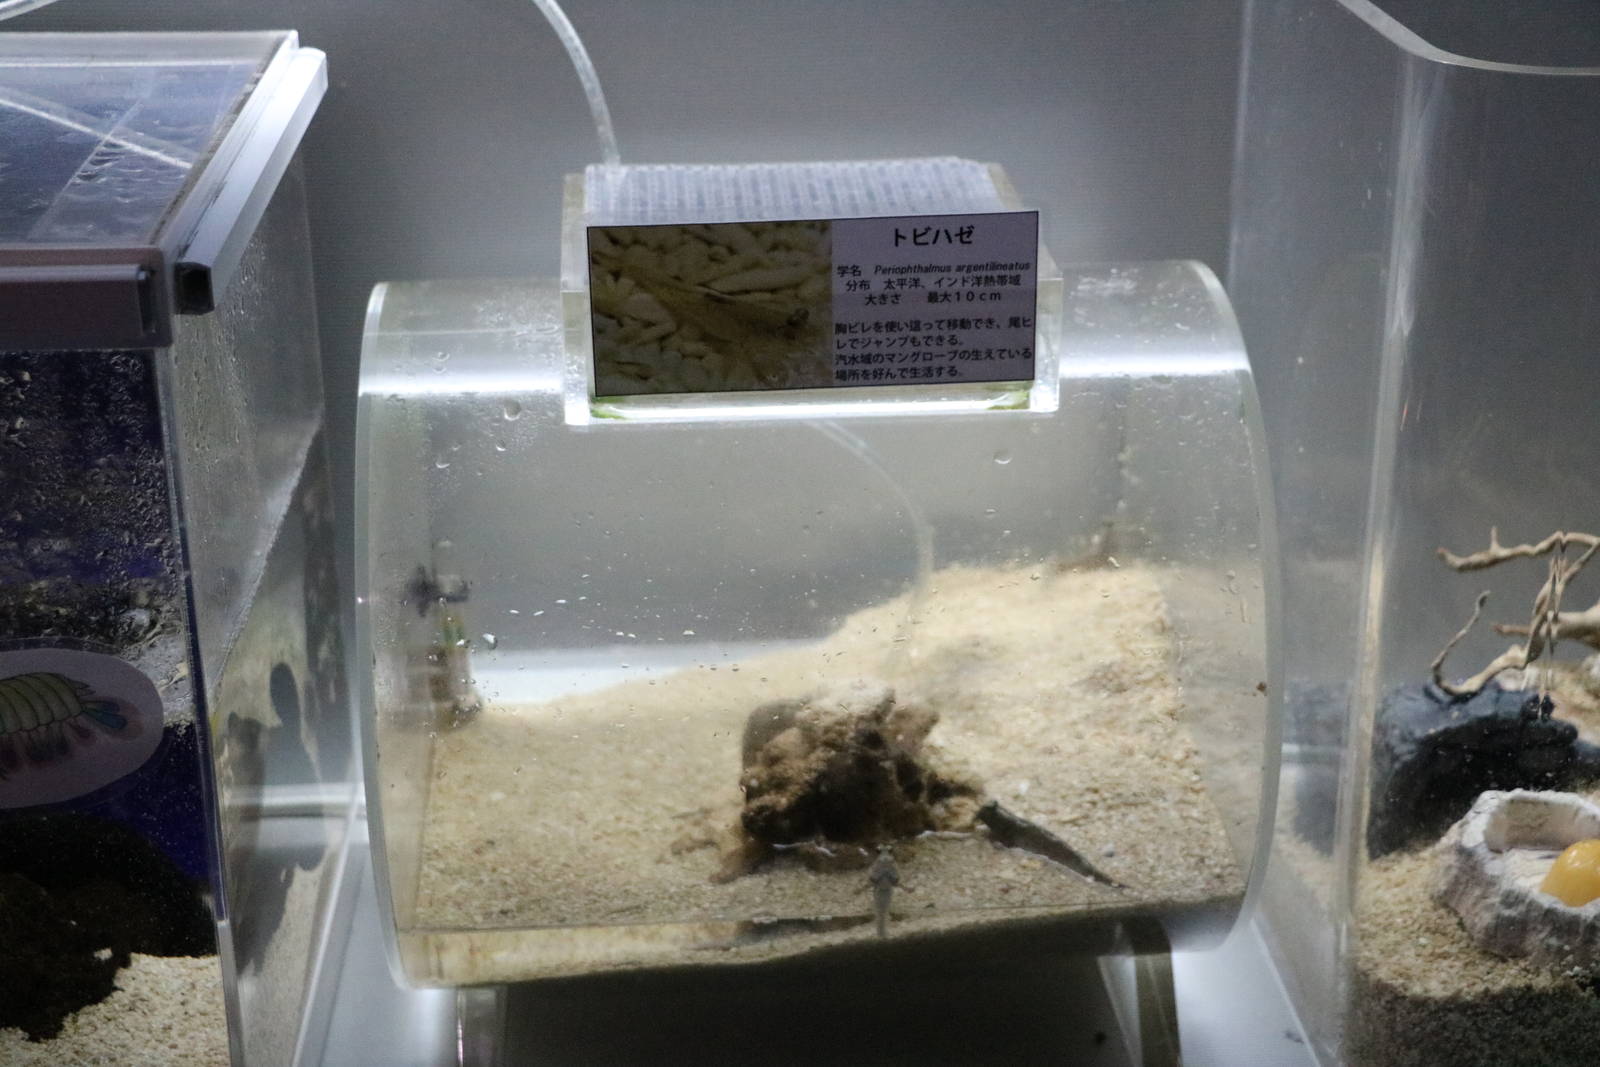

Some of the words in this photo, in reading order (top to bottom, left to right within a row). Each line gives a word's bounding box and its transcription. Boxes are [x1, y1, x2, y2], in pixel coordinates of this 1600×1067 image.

[894, 225, 975, 247] トビハゼ
[836, 264, 862, 277] 学名
[874, 263, 952, 276] Periophthalmus
[846, 279, 871, 291] 分布
[865, 293, 901, 306] 大きさ
